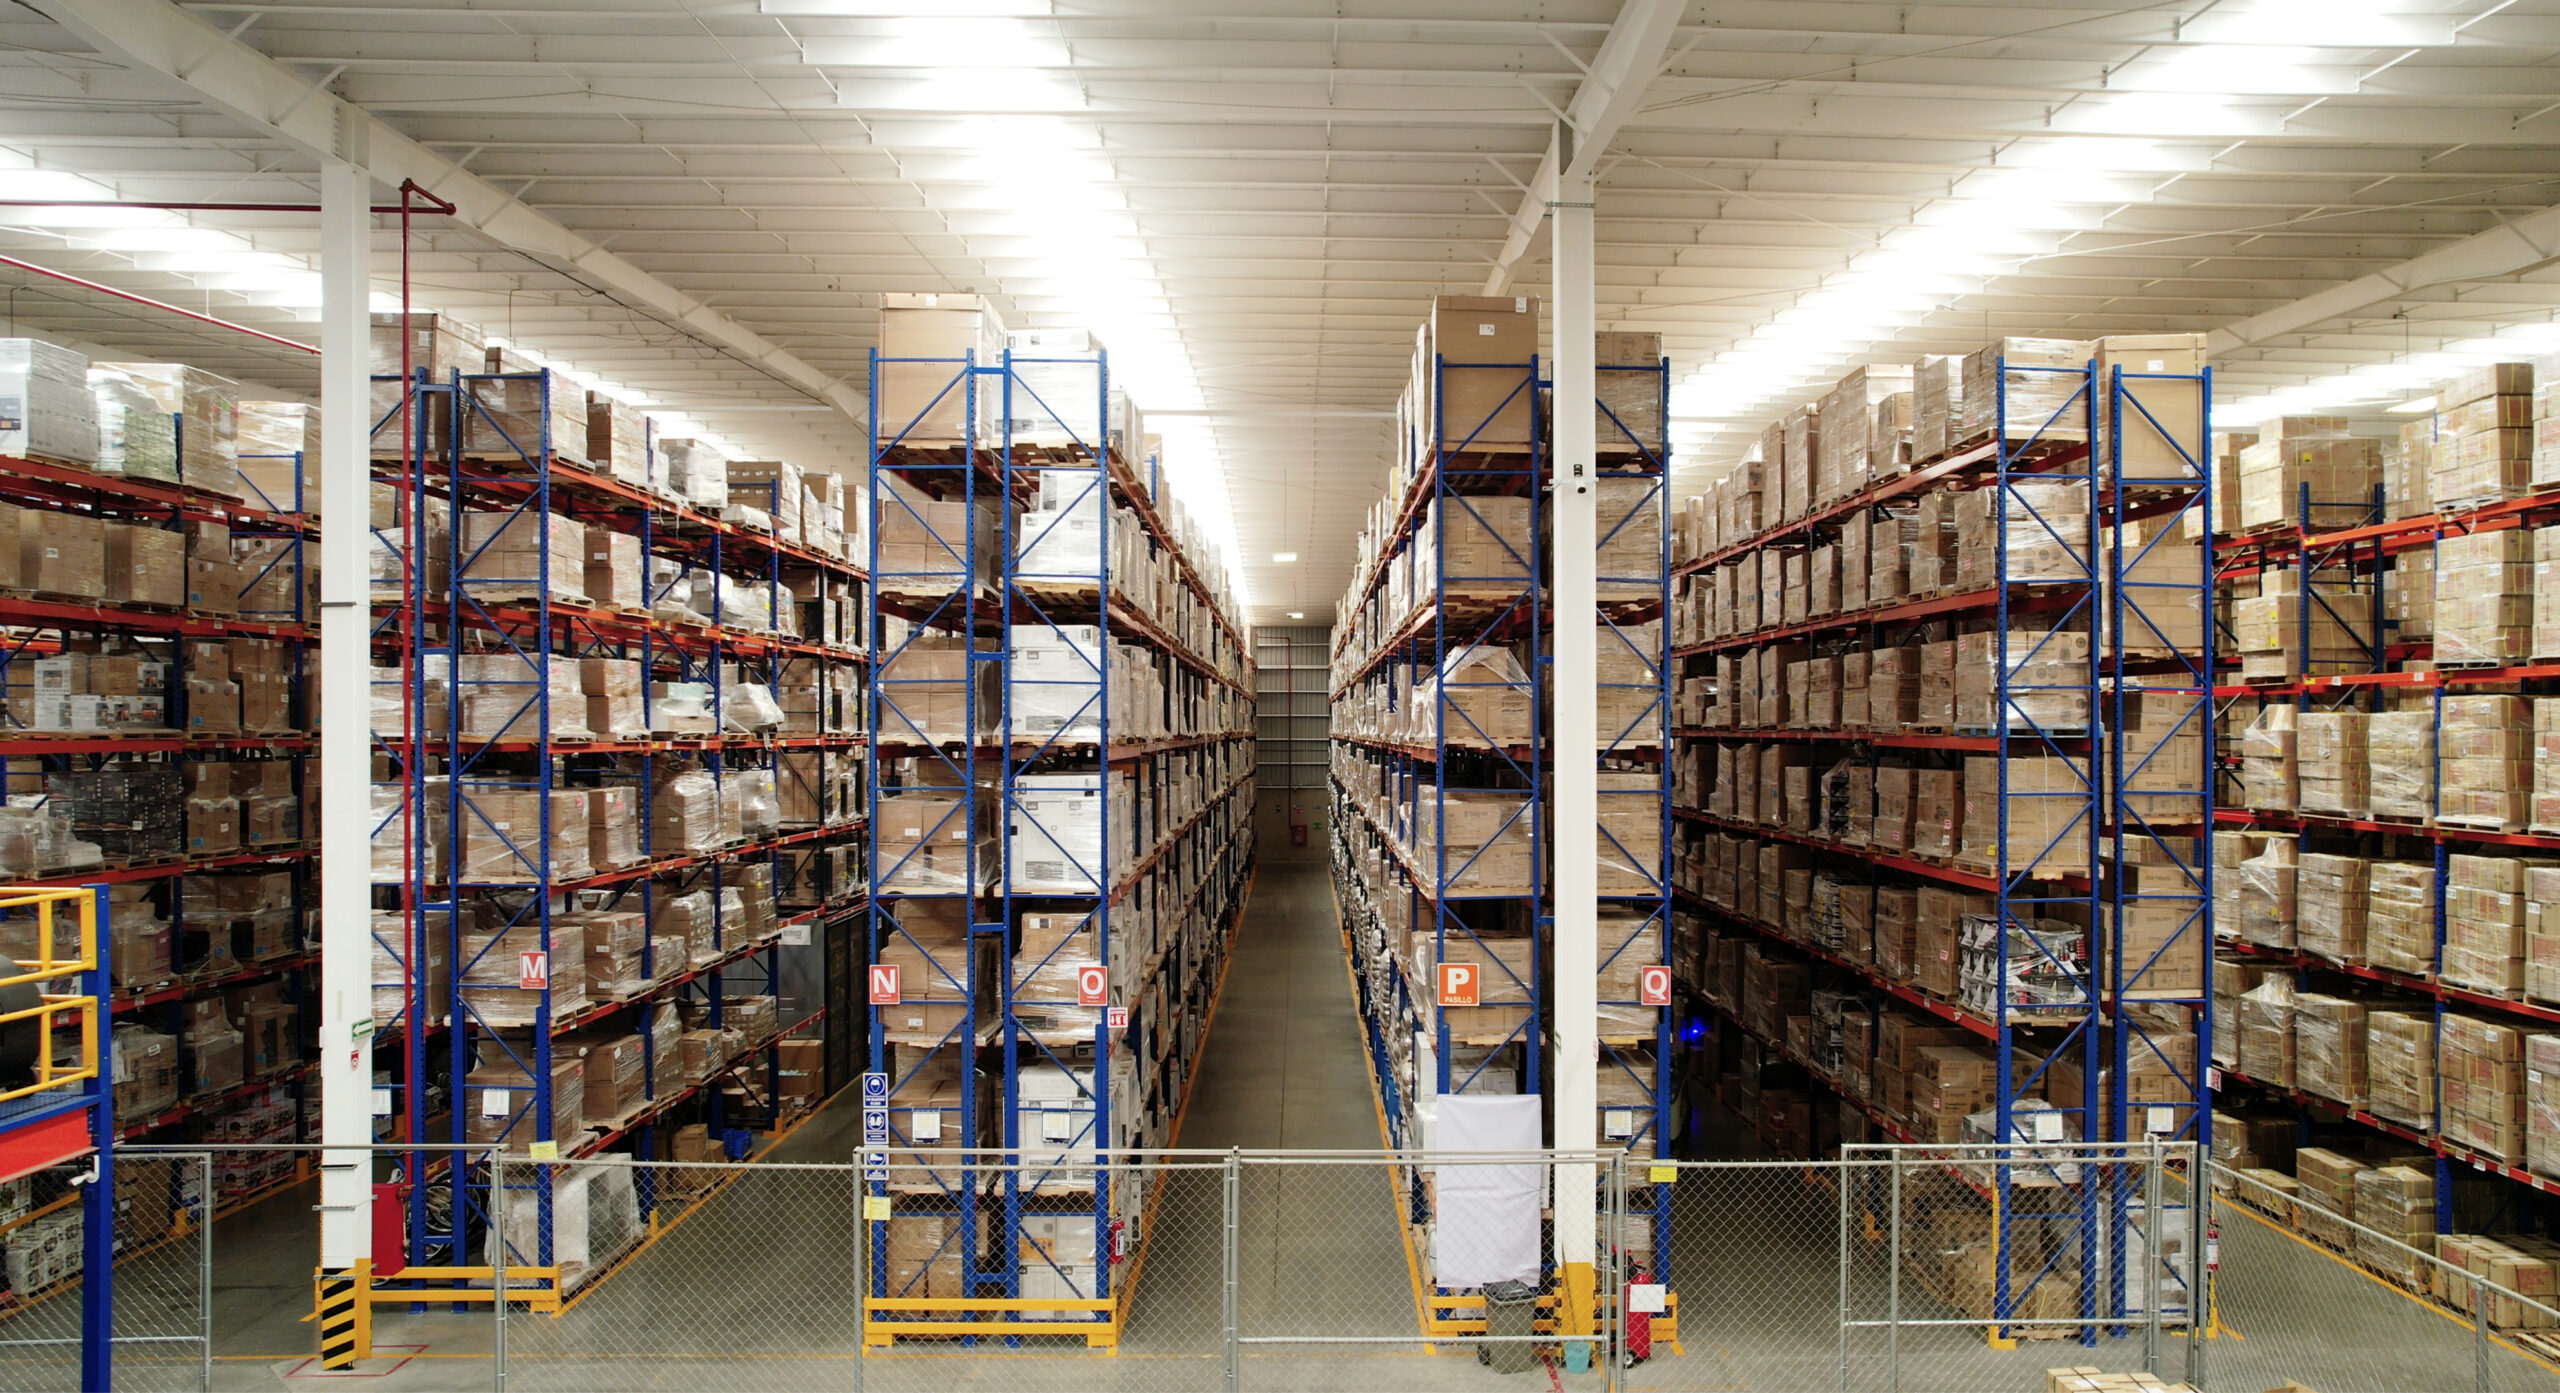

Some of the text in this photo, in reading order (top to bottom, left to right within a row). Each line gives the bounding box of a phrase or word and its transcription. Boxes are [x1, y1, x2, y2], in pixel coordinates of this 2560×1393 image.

[522, 955, 545, 978] M
[873, 969, 896, 993] N
[1081, 970, 1104, 995] O
[1447, 967, 1470, 994] P
[1645, 970, 1667, 1000] Q
[1444, 996, 1472, 1004] PASILLO
